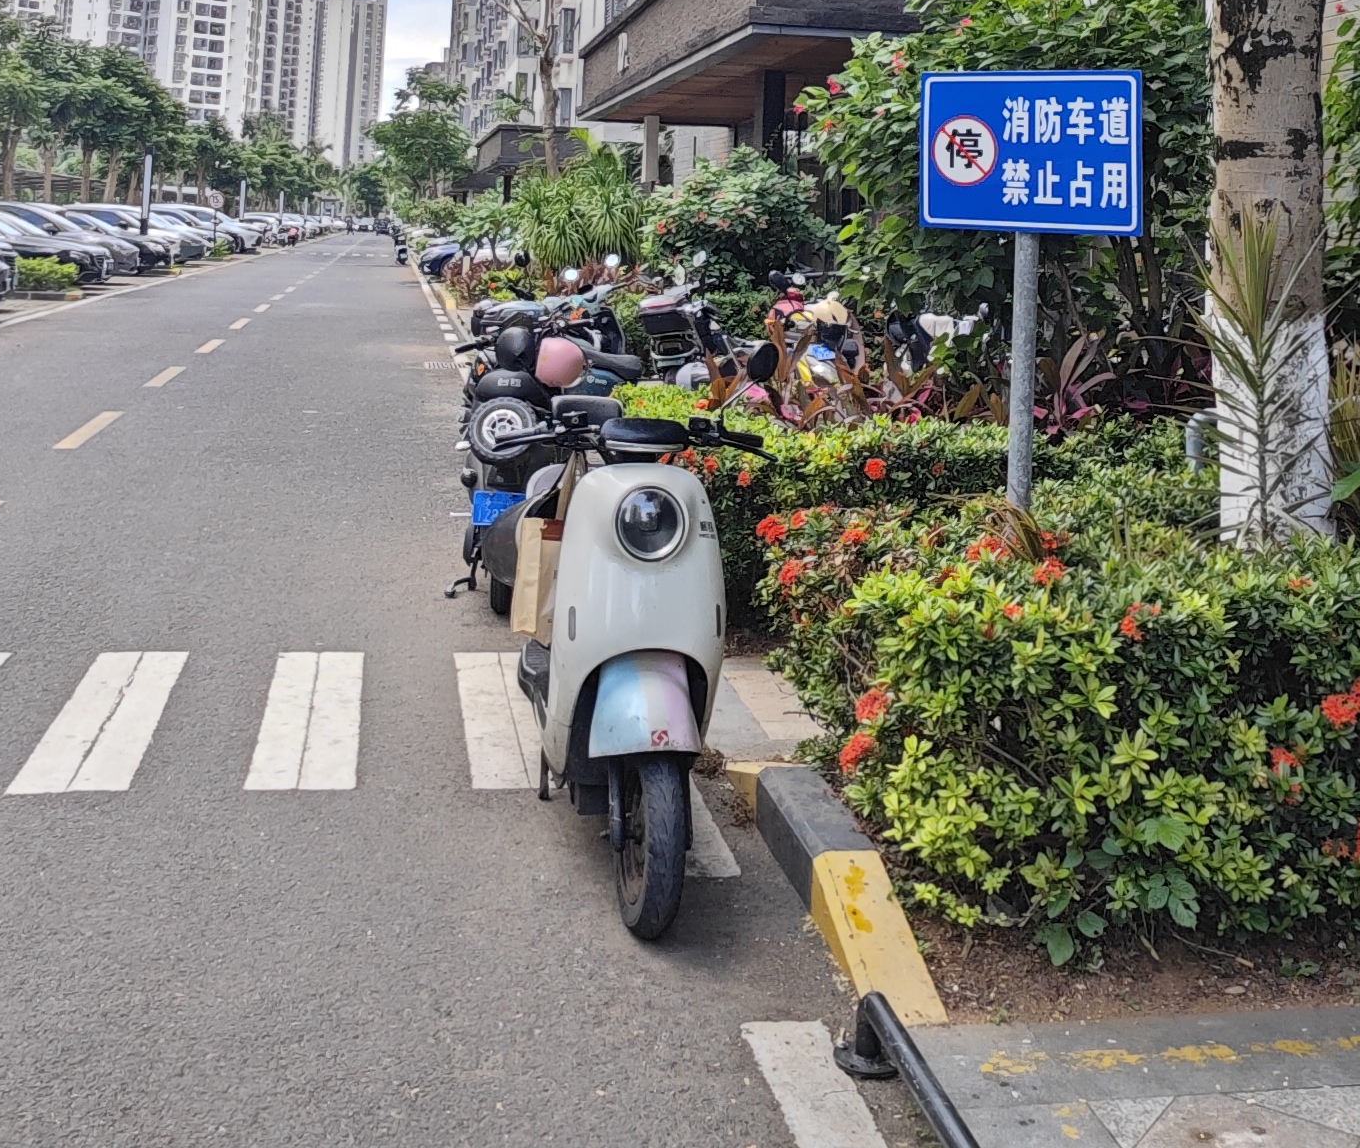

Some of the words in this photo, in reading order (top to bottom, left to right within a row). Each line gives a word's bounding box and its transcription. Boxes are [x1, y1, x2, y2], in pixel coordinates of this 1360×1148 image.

[1002, 96, 1130, 145] 消防车道
[945, 128, 984, 169] 停
[1001, 158, 1128, 209] 禁止占用
